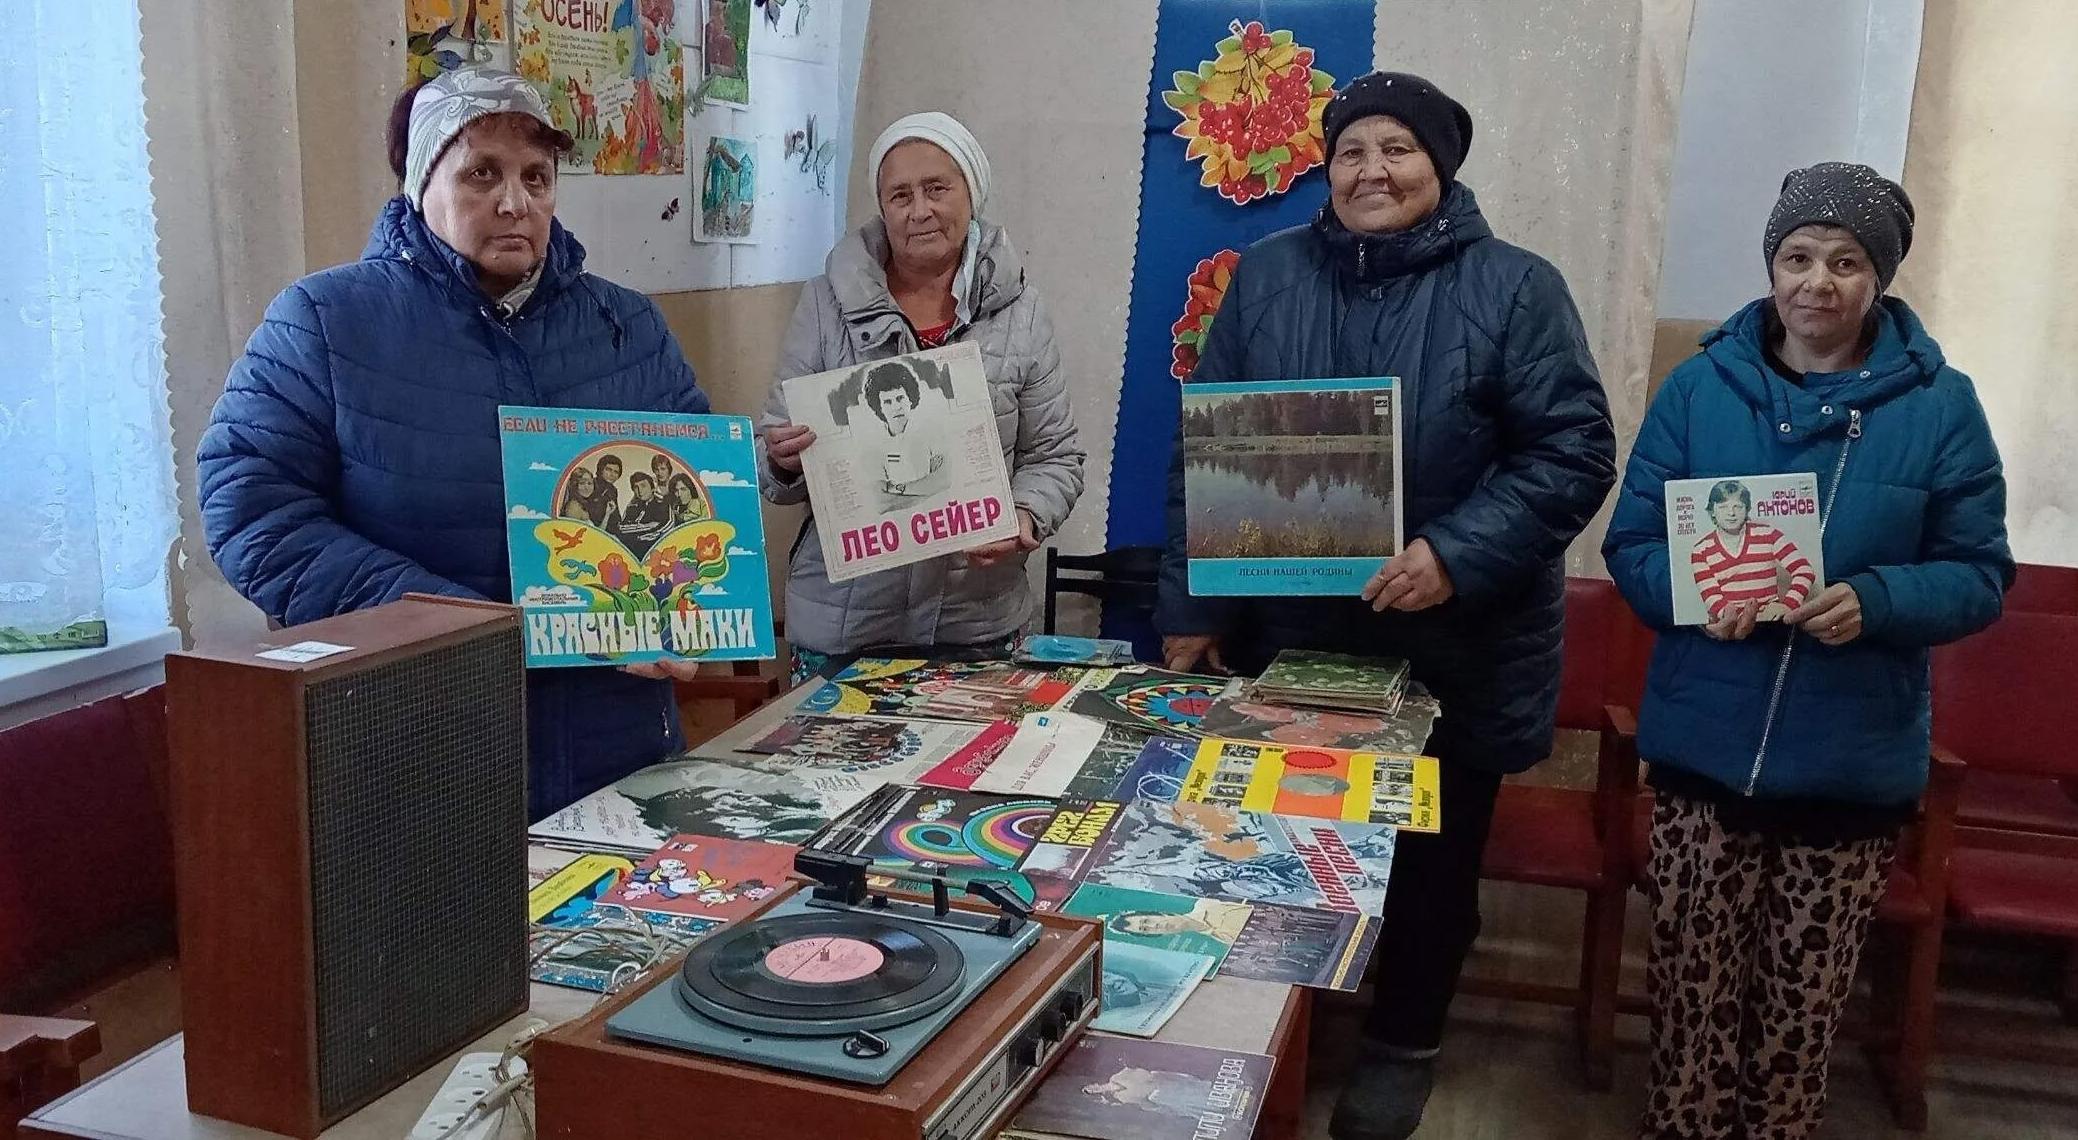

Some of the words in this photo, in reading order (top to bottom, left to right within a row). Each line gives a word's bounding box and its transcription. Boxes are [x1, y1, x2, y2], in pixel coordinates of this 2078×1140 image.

[540, 0, 609, 33] ОСЕНЬ!
[504, 417, 547, 432] ЕСЛИ
[552, 418, 578, 433] НЕ
[1772, 488, 1796, 499] ЮРИЙ
[1757, 499, 1815, 517] АНТОНОВ
[841, 520, 900, 563] ЛЕО
[910, 496, 1001, 545] СЕЙЕР
[1238, 567, 1270, 577] ПЕСНИ
[1273, 567, 1308, 577] НАШЕЙ
[1312, 567, 1353, 577] РОДИНЫ
[527, 611, 661, 656] КРАСНЫЕ
[669, 608, 756, 652] МАКИ
